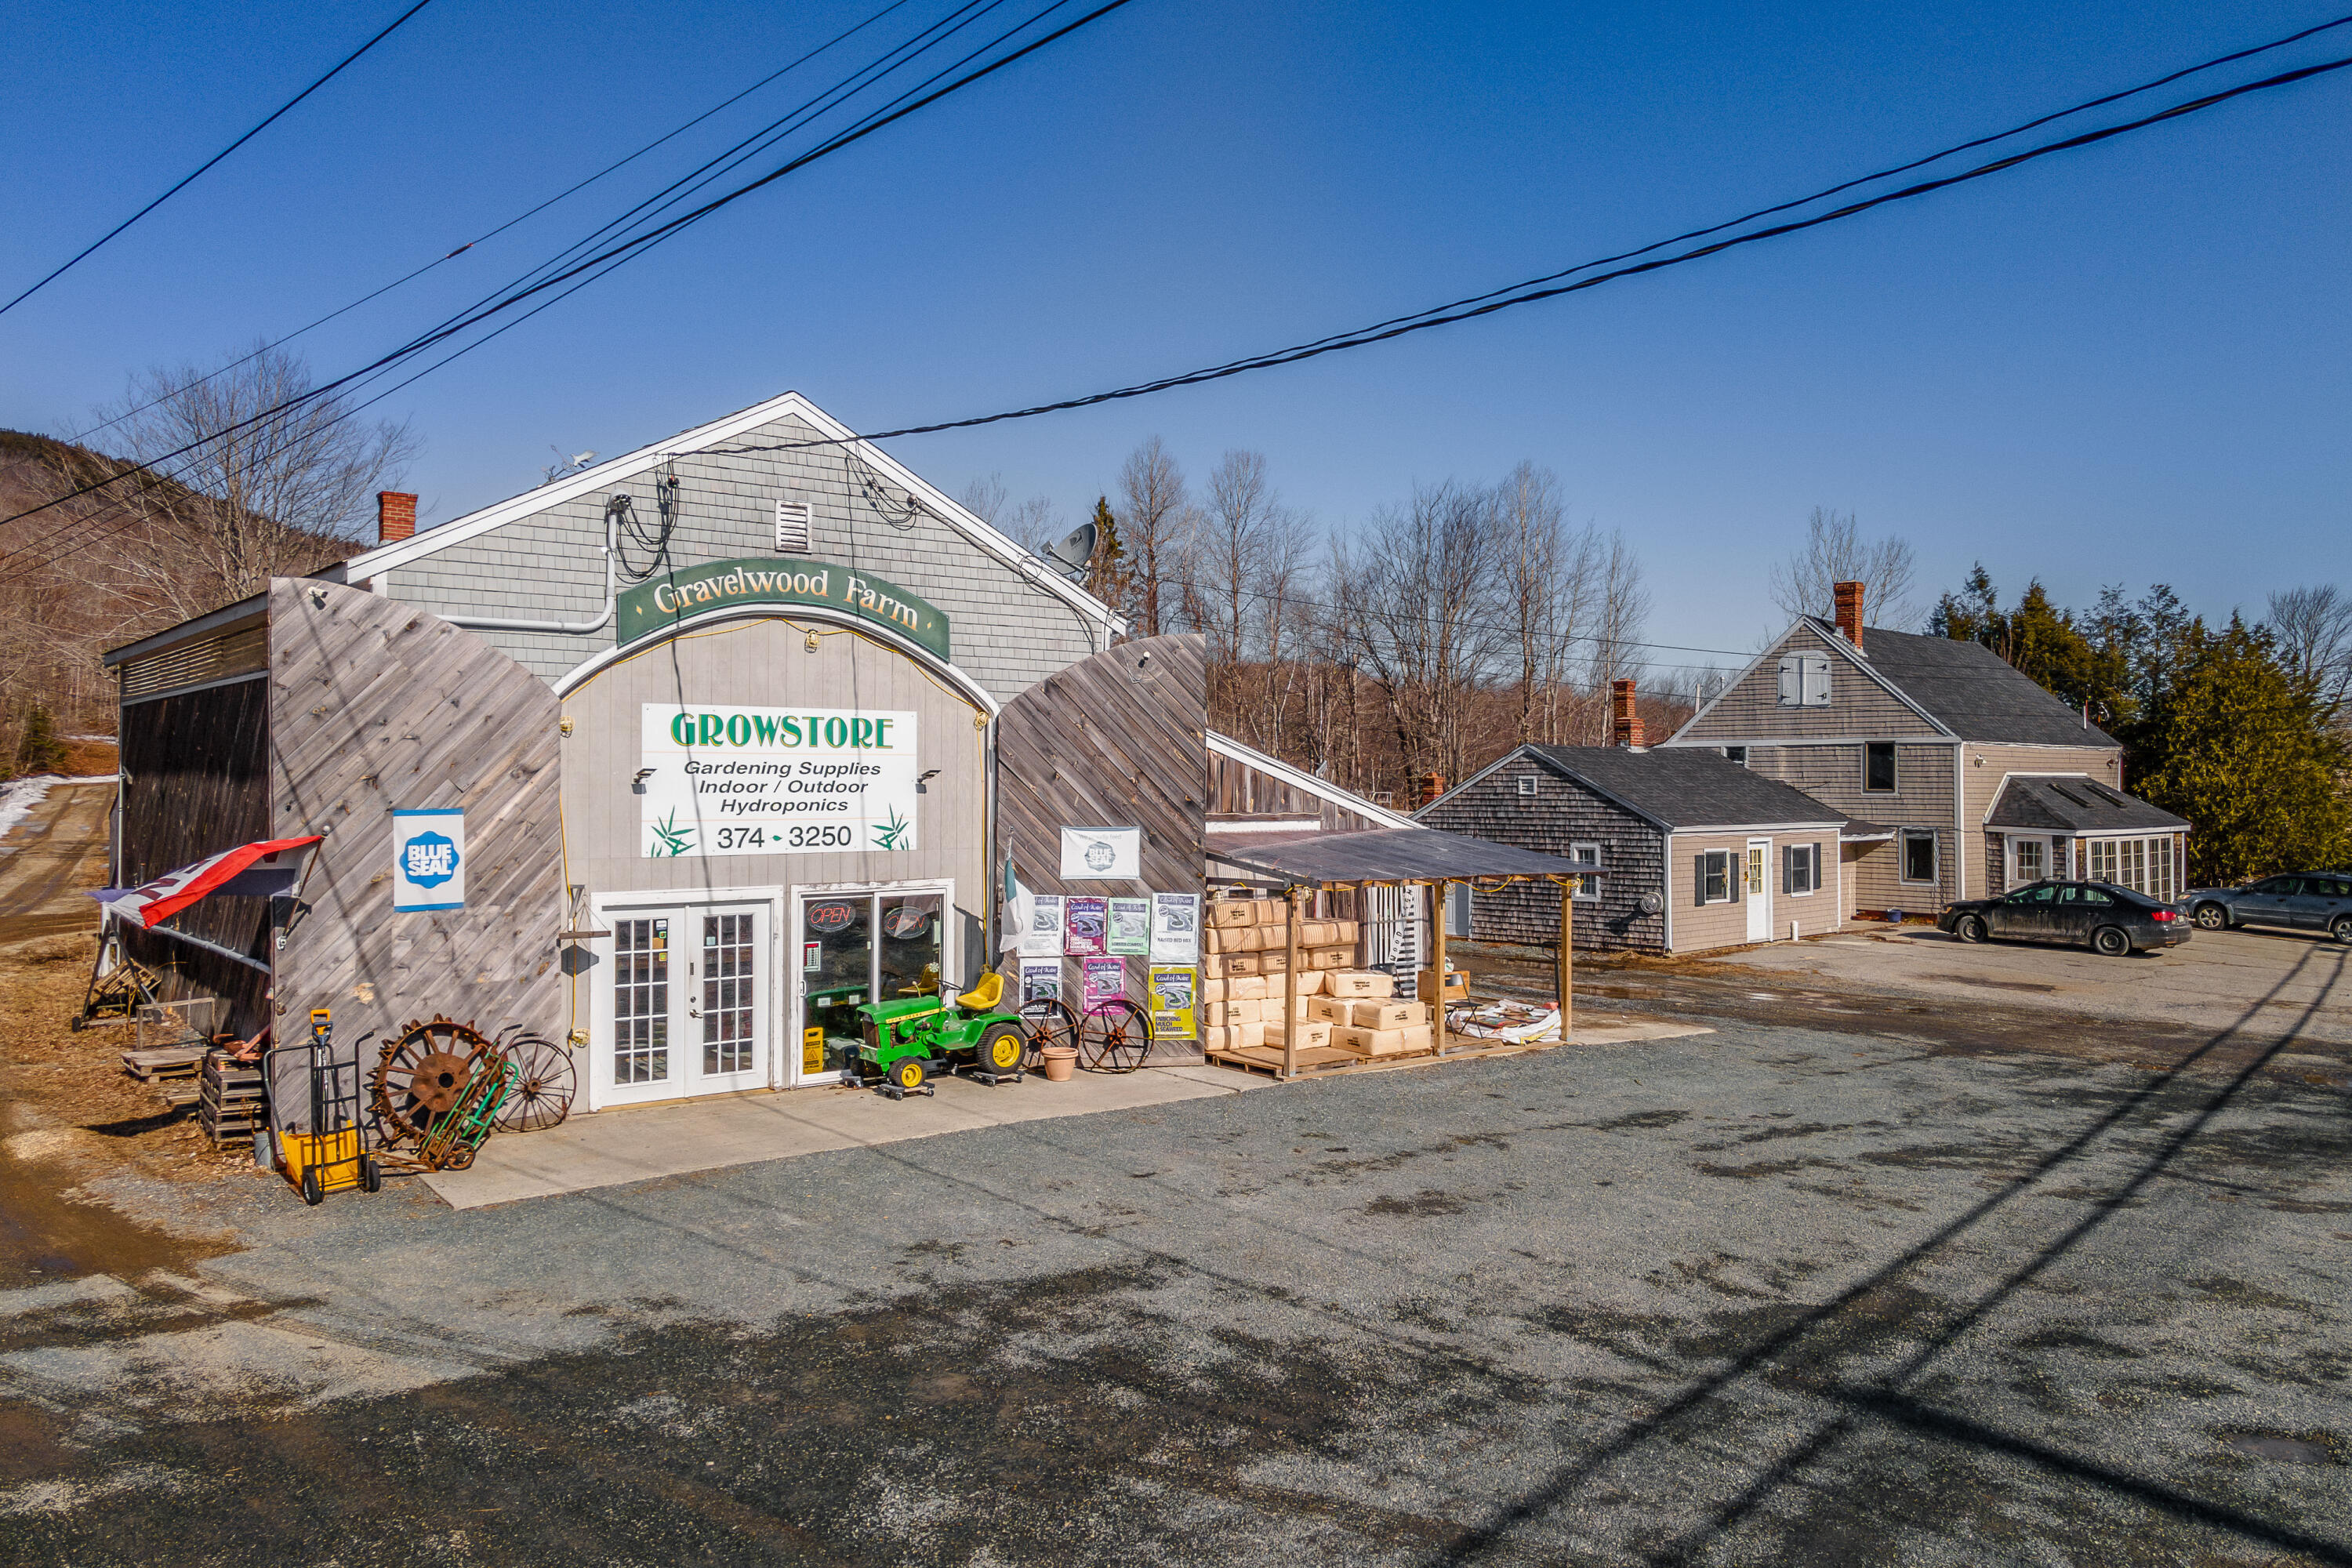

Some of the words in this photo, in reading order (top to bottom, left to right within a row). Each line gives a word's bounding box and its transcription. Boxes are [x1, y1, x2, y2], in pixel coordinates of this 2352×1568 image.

[654, 566, 829, 614] Gravelwood
[843, 575, 918, 631] Farm
[670, 712, 894, 750] GROWSTORE
[684, 760, 792, 777] Gardening
[799, 761, 881, 777] Supplies
[699, 780, 767, 794] Indoor
[774, 781, 782, 793] /
[788, 780, 868, 793] Outdoor
[720, 798, 848, 816] Hydroponics
[717, 828, 765, 849] 374
[789, 826, 851, 848] 3250
[408, 844, 452, 861] BLUE
[407, 859, 452, 877] SEAL
[811, 906, 852, 924] OPEN
[887, 914, 925, 930] ON
